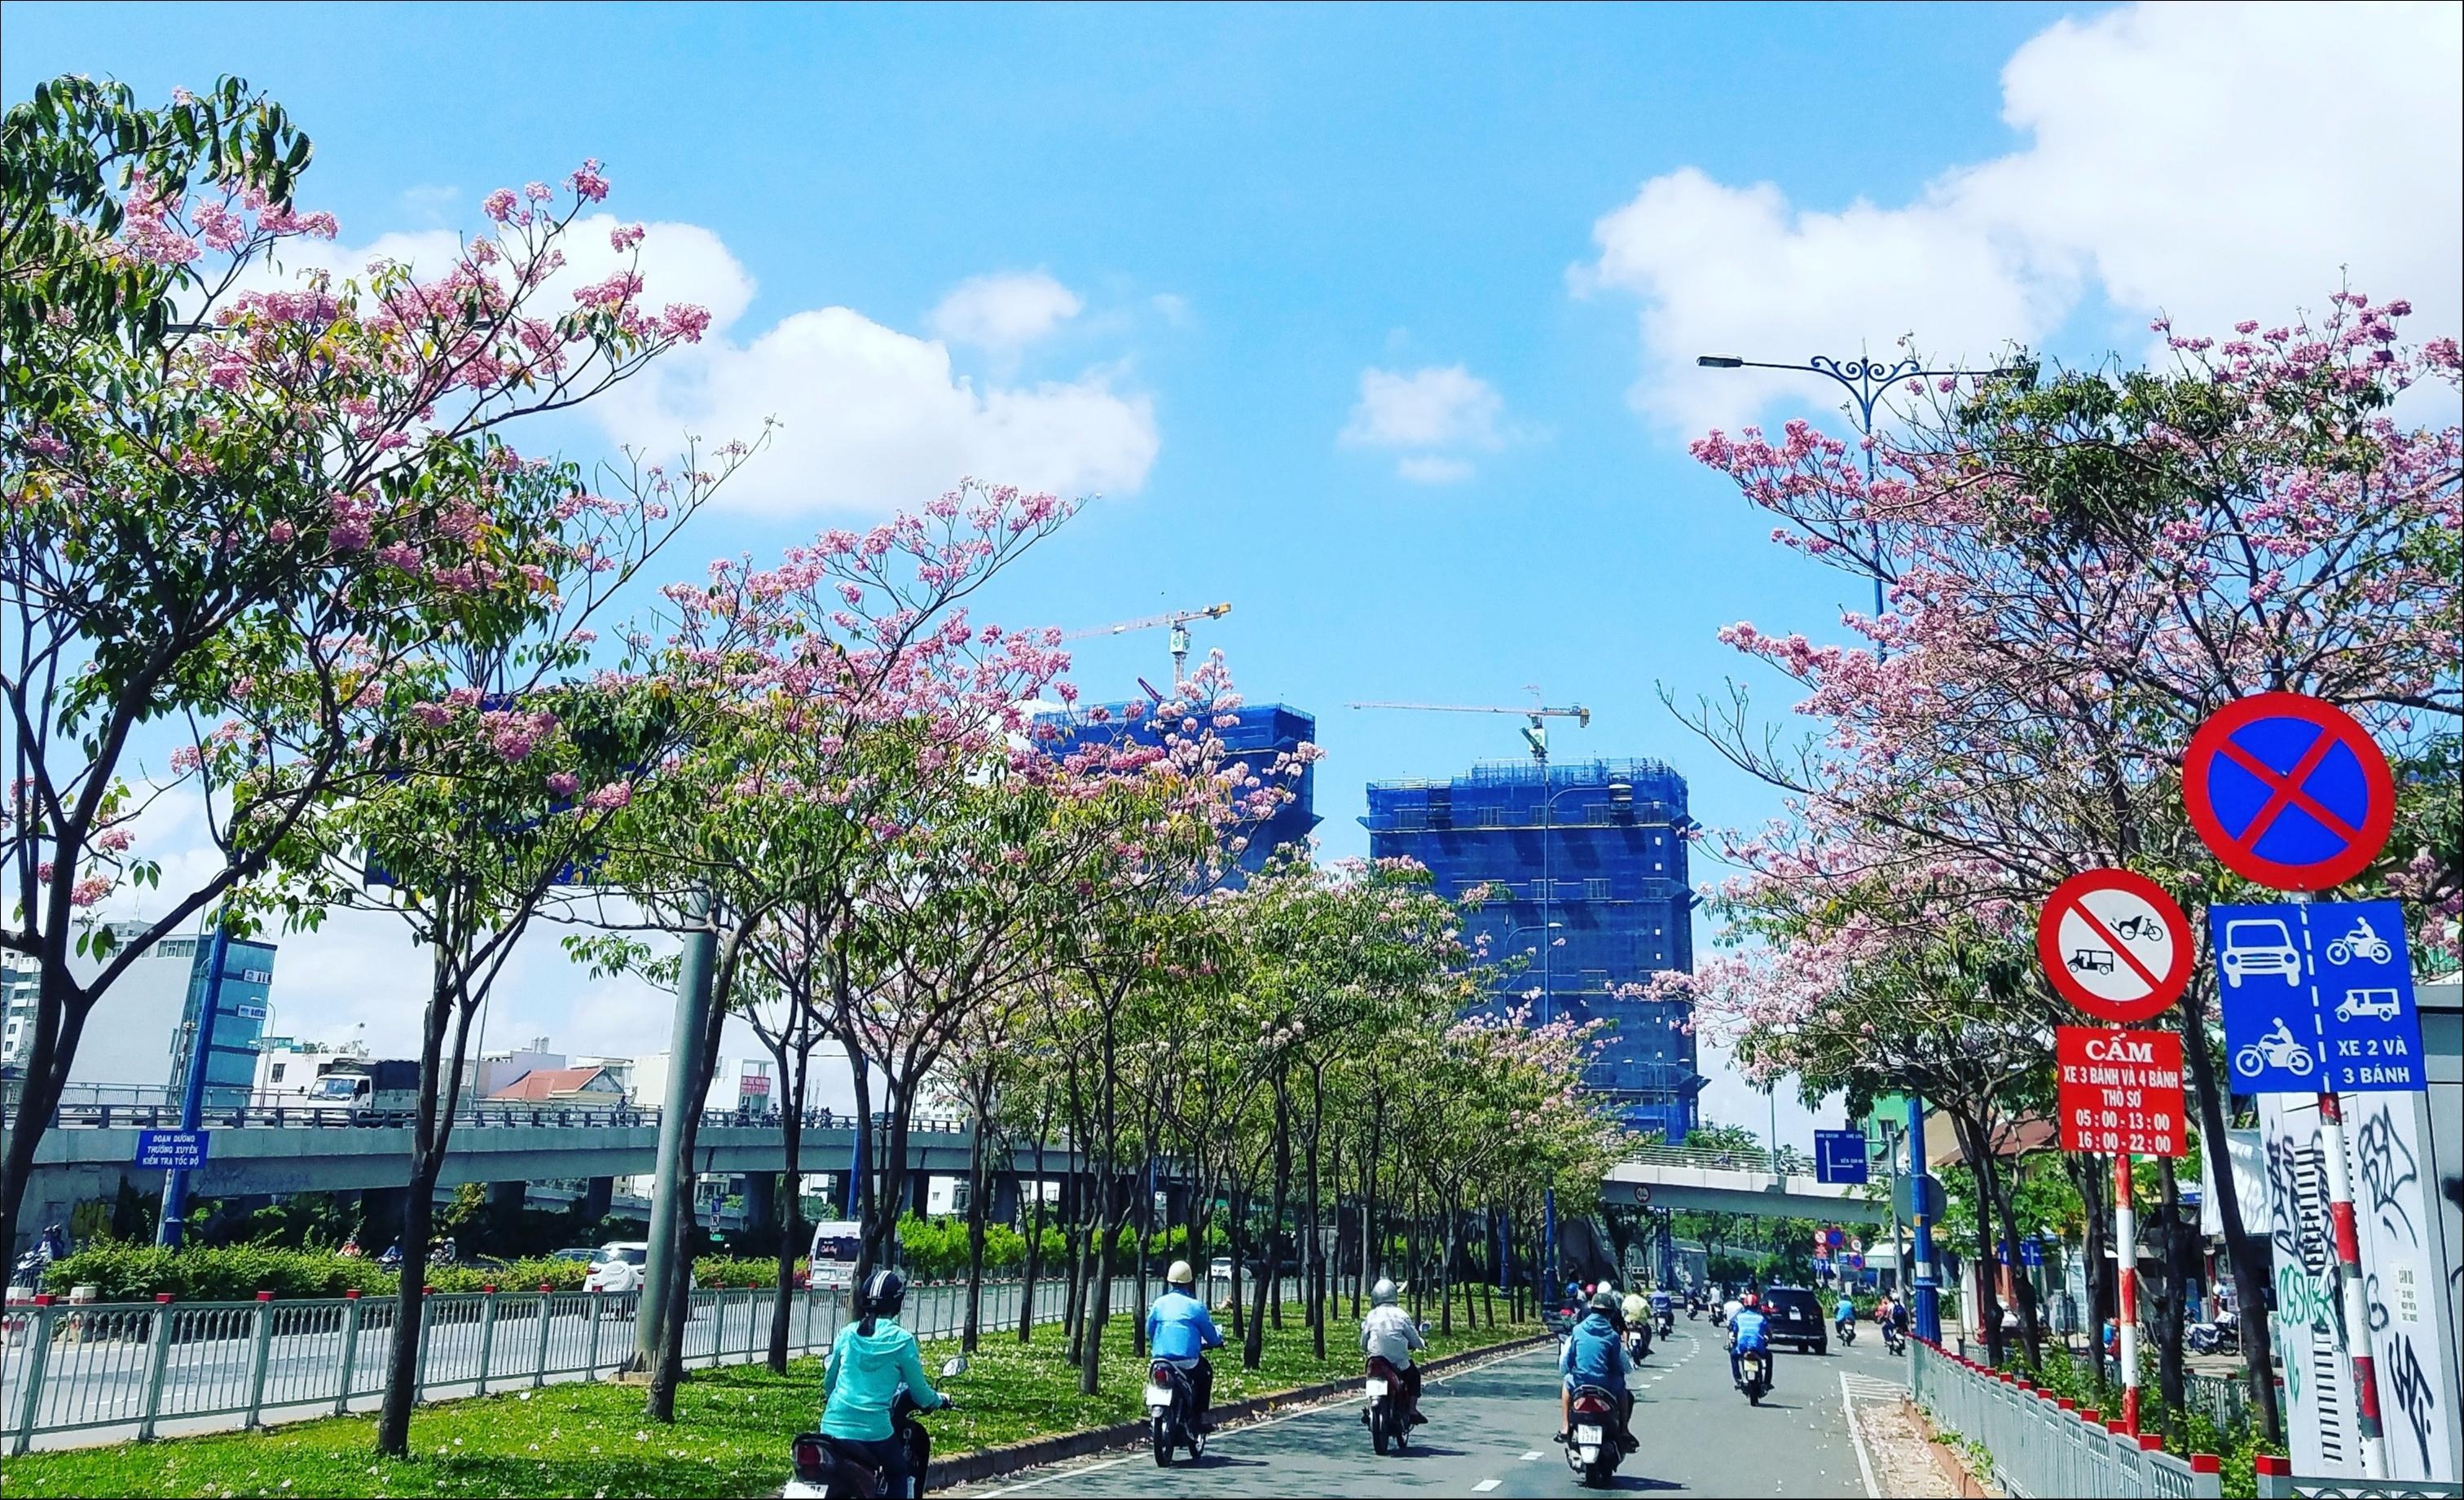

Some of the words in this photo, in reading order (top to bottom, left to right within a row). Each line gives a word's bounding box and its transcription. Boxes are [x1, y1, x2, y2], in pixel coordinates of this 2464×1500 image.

[2085, 1032, 2154, 1063] CẤM
[2336, 1040, 2361, 1056] XE
[2367, 1040, 2378, 1056] 2
[2383, 1035, 2408, 1056] VÀ
[2063, 1065, 2078, 1083] XE
[2079, 1067, 2088, 1084] 3
[2121, 1064, 2136, 1087] VÀ
[2138, 1070, 2146, 1087] 4
[2343, 1067, 2355, 1084] 3
[2360, 1062, 2410, 1084] BÁNH
[2101, 1086, 2124, 1107] THÔ
[161, 1157, 174, 1165] TRA
